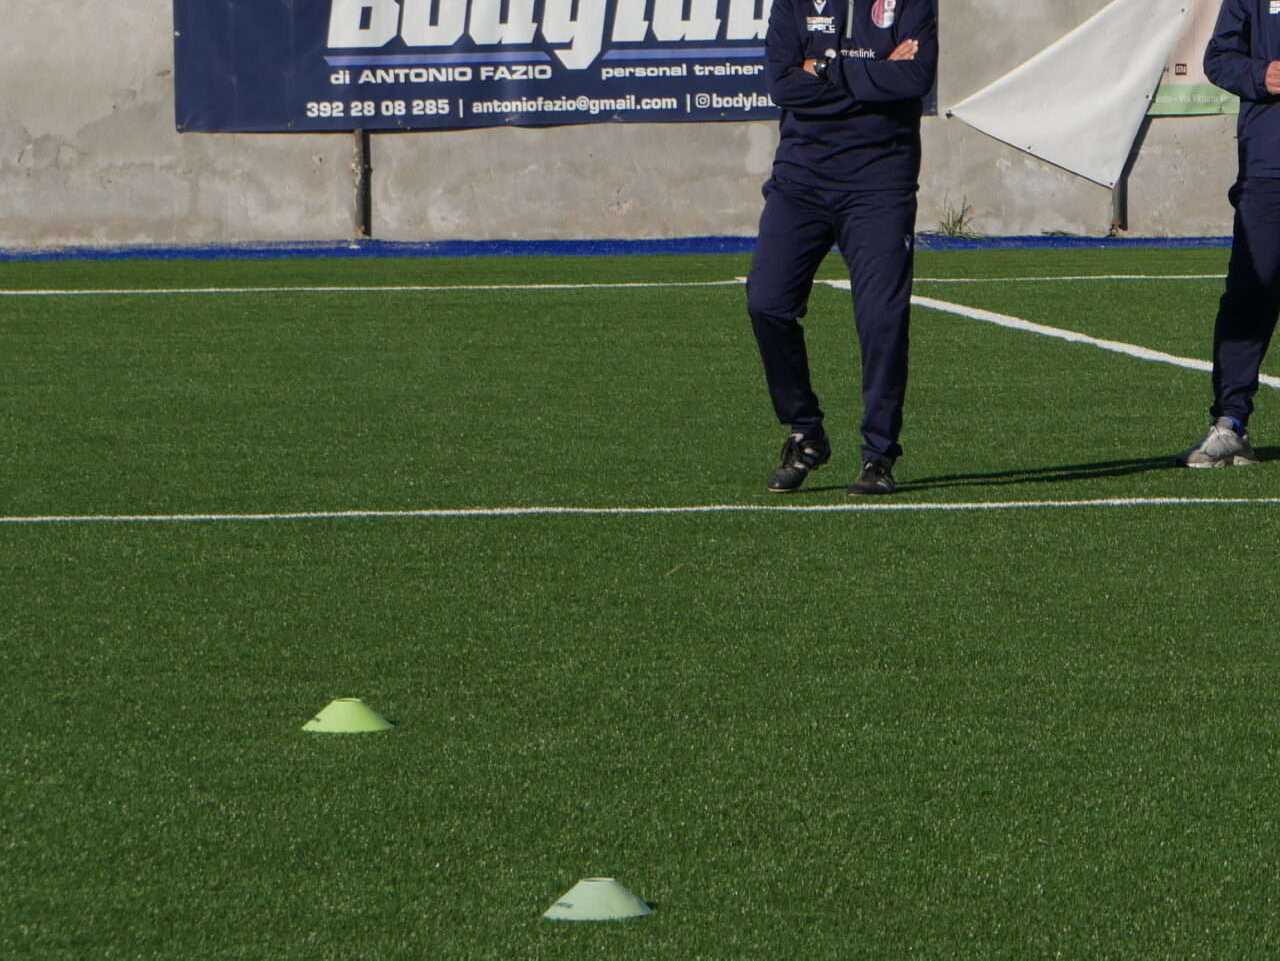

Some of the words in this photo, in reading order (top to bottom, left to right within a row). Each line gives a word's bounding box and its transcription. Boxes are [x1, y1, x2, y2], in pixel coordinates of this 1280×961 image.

[330, 70, 350, 85] di
[358, 66, 473, 84] ANTONIO
[480, 64, 553, 81] FAZIO
[601, 63, 687, 80] personal
[694, 61, 764, 76] trainer
[306, 101, 344, 118] 392
[350, 100, 375, 117] 28
[381, 100, 406, 116] 08
[412, 98, 450, 116] 285
[472, 94, 677, 115] antoniofazio@gmail.com
